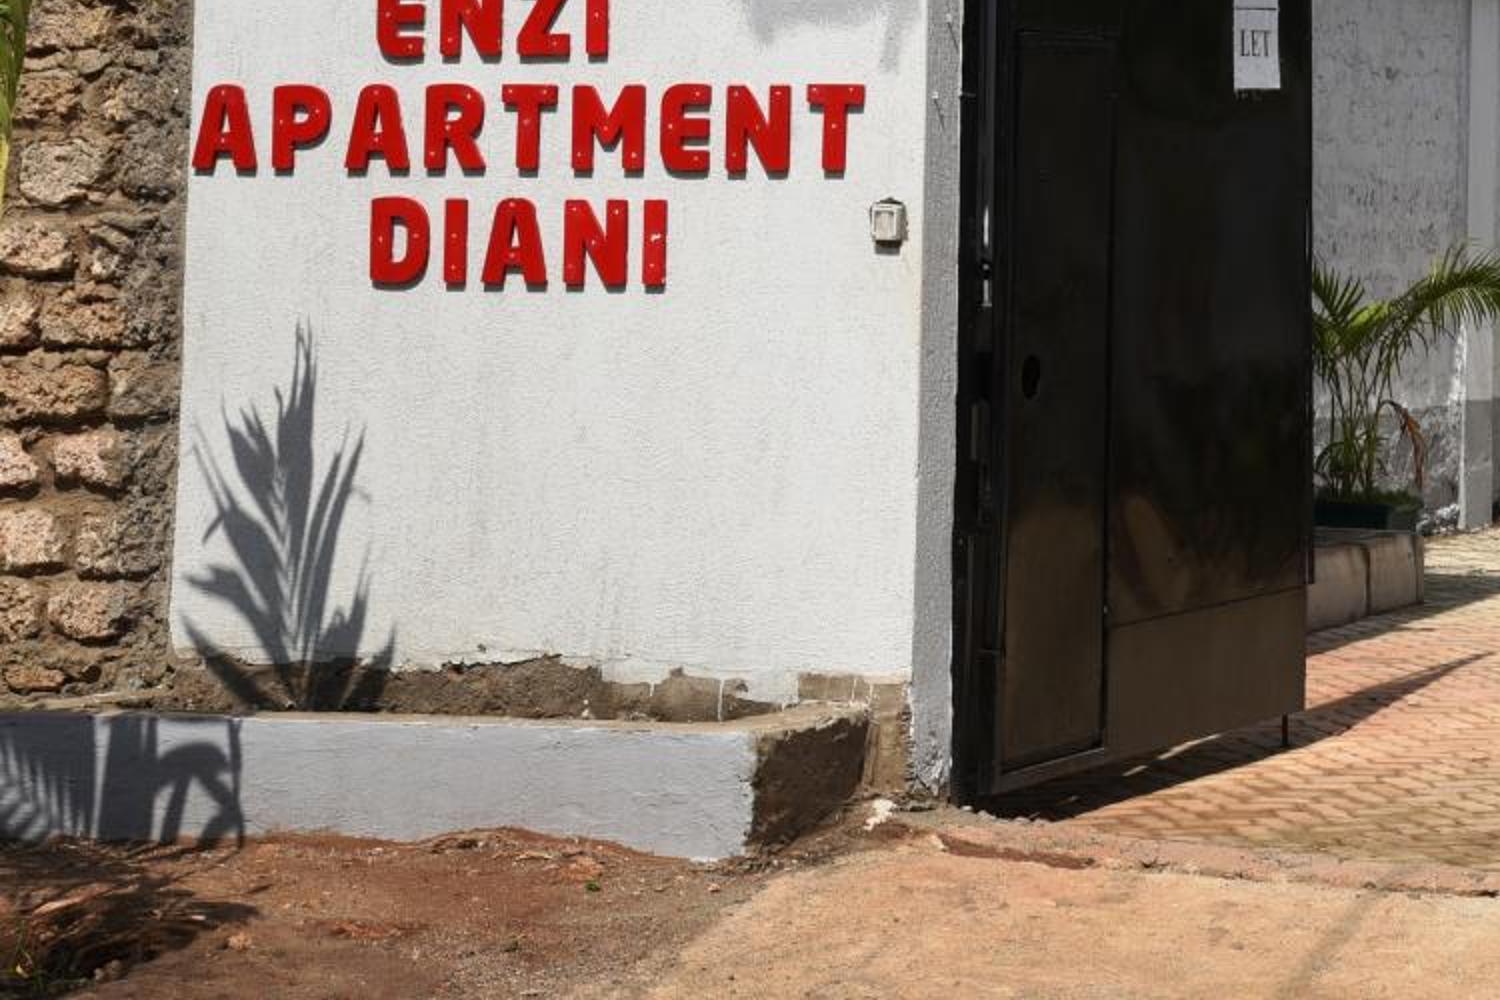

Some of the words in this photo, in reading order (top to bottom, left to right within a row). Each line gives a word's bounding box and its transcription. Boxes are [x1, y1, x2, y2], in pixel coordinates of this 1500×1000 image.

[1239, 29, 1271, 57] LET
[191, 83, 866, 178] APARTMENT
[369, 196, 668, 292] DIANI
